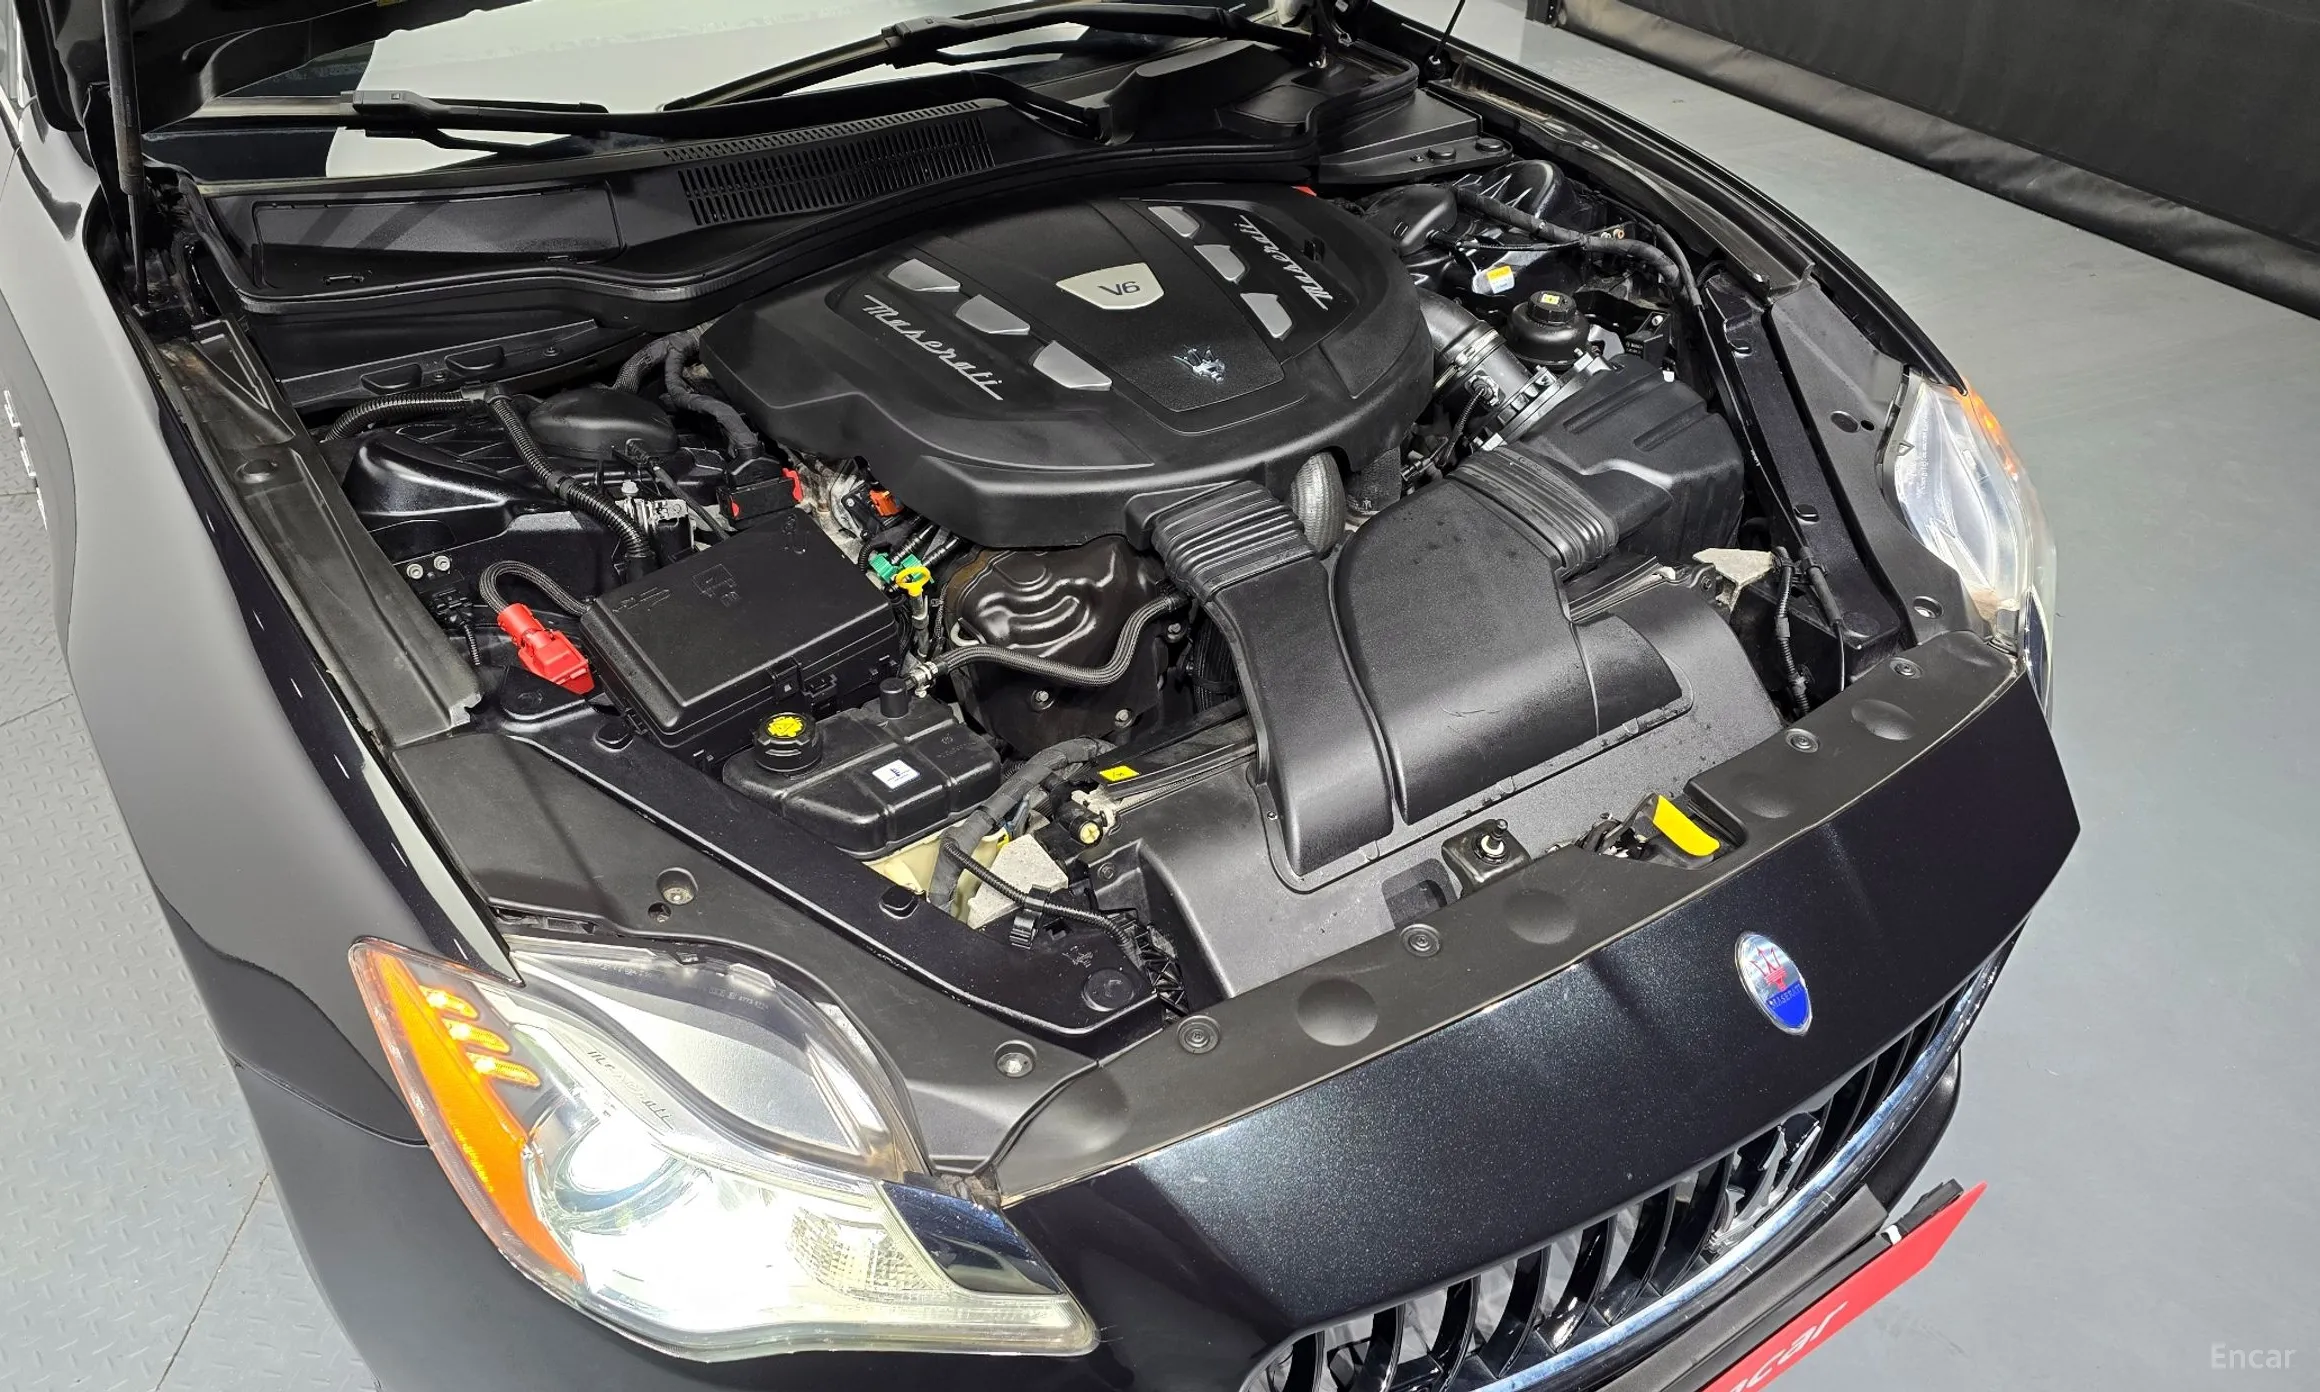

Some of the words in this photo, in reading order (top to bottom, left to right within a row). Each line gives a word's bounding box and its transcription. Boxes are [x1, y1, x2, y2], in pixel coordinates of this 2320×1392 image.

[1097, 281, 1140, 295] V6
[1233, 214, 1333, 311] Maserati
[862, 294, 1004, 401] Maserati
